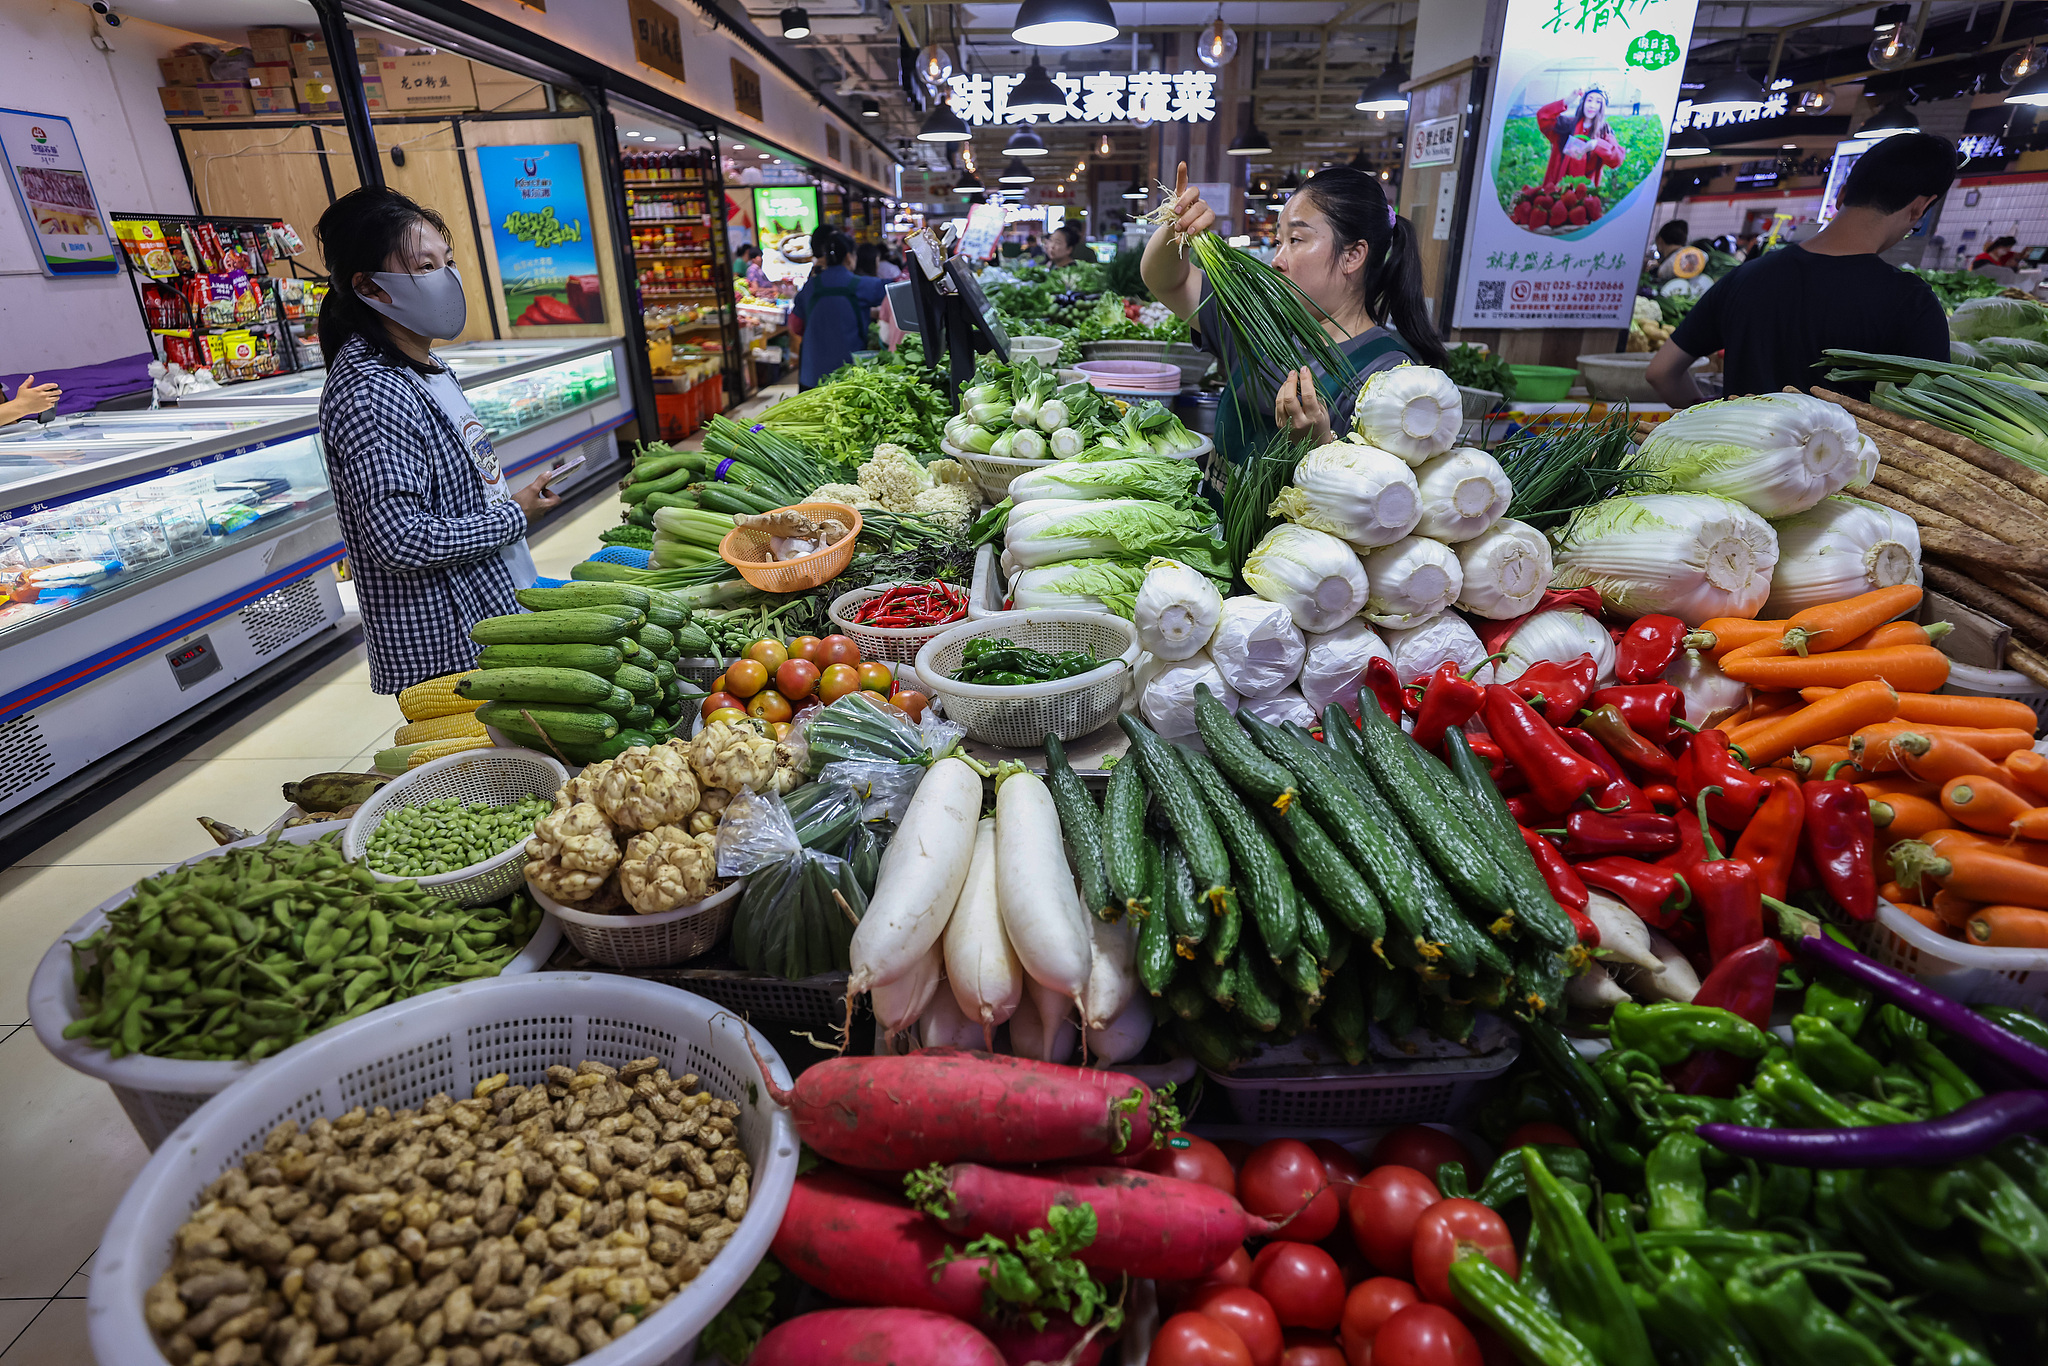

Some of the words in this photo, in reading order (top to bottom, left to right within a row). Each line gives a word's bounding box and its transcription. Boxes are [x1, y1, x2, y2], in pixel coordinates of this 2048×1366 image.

[1541, 0, 1668, 34] 去撒
[1637, 38, 1670, 50] 假日去
[1426, 127, 1454, 147] 禁止吸烟
[1553, 281, 1625, 291] 025-52120666
[1552, 293, 1570, 302] 133
[1572, 293, 1596, 302] 4780
[1598, 293, 1623, 302] 3732
